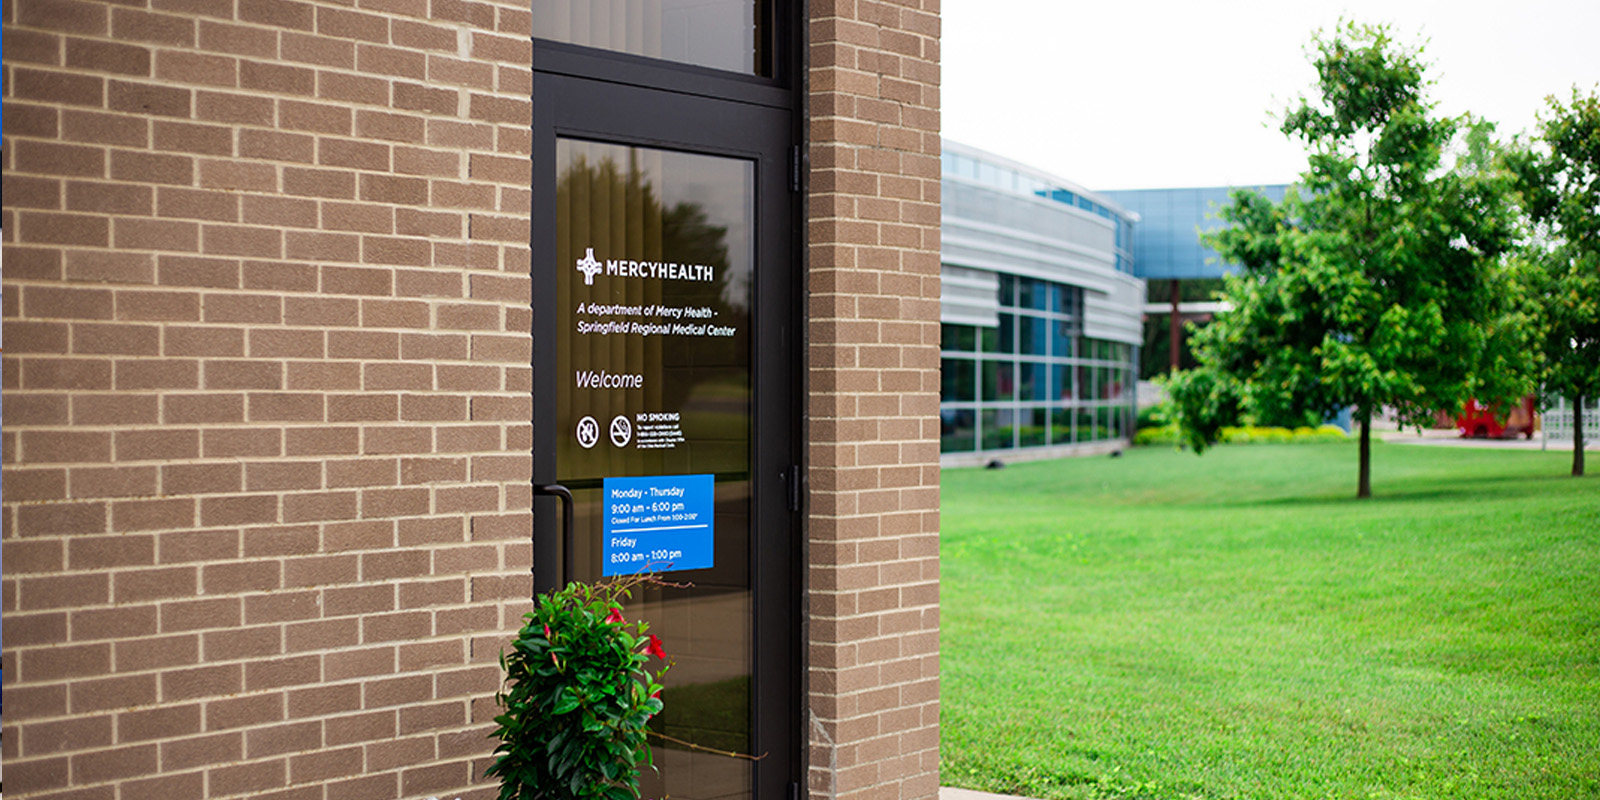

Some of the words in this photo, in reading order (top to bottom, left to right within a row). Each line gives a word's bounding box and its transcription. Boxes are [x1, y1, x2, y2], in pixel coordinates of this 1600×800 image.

[607, 260, 713, 281] MERCYHEALTH
[577, 303, 585, 314] A
[587, 303, 642, 316] department
[644, 305, 655, 316] of
[655, 305, 683, 319] Mercy
[684, 307, 712, 318] Health
[577, 321, 629, 334] Springfield
[631, 322, 670, 336] Regional
[672, 323, 706, 335] Medical
[707, 325, 736, 336] Center
[576, 370, 643, 388] Welcome
[636, 413, 647, 421] NO
[649, 413, 680, 421] SMOKING
[611, 488, 642, 499] Monday
[650, 487, 684, 497] Thursday
[611, 504, 630, 514] 9:00
[652, 502, 670, 512] 6:00
[672, 503, 684, 512] pm
[611, 537, 637, 548] Friday
[611, 552, 629, 563] 8:00
[632, 553, 644, 561] am
[651, 550, 668, 559] 1:00
[669, 551, 681, 560] pm
